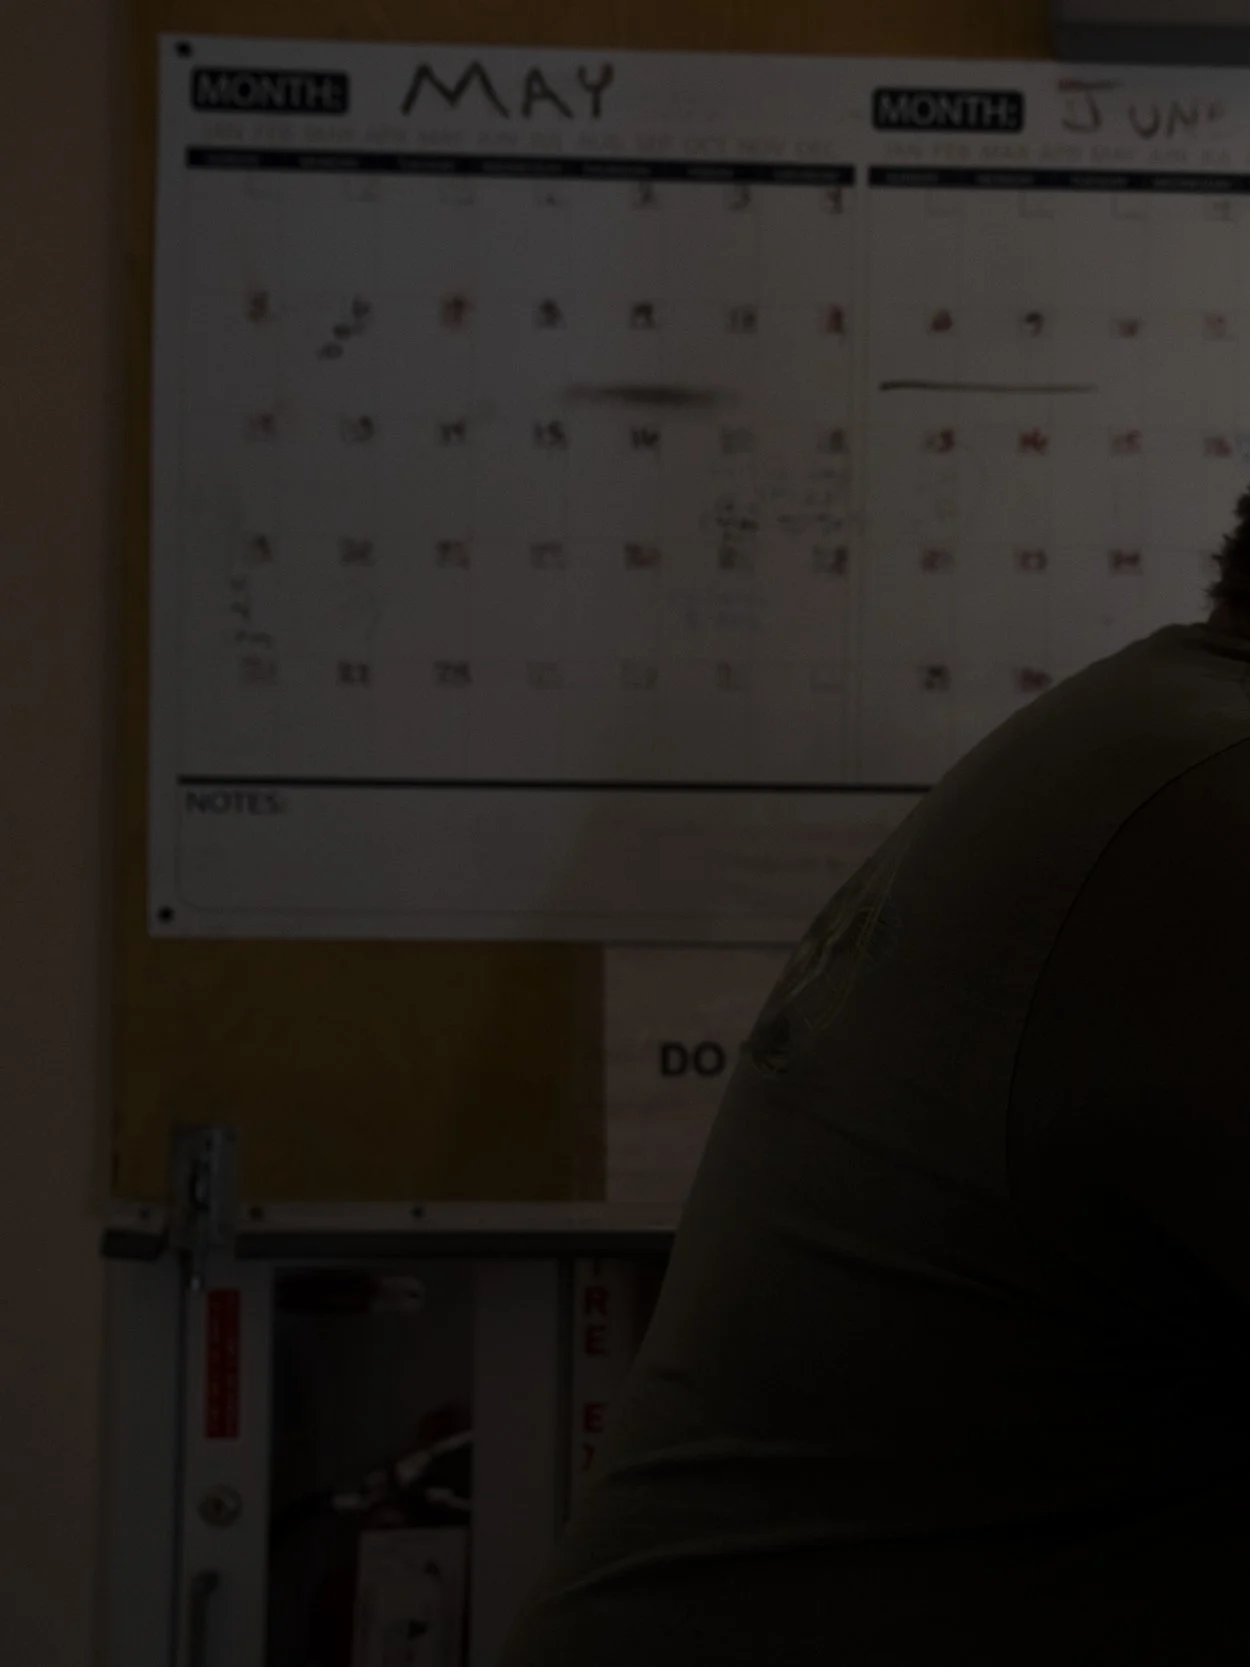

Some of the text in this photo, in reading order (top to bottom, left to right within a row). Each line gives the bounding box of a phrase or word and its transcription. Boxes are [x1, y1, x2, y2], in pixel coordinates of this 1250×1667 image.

[198, 72, 345, 110] MONTH:
[401, 61, 614, 119] MAY
[879, 91, 1020, 129] MONTH:
[660, 1043, 726, 1076] DO
